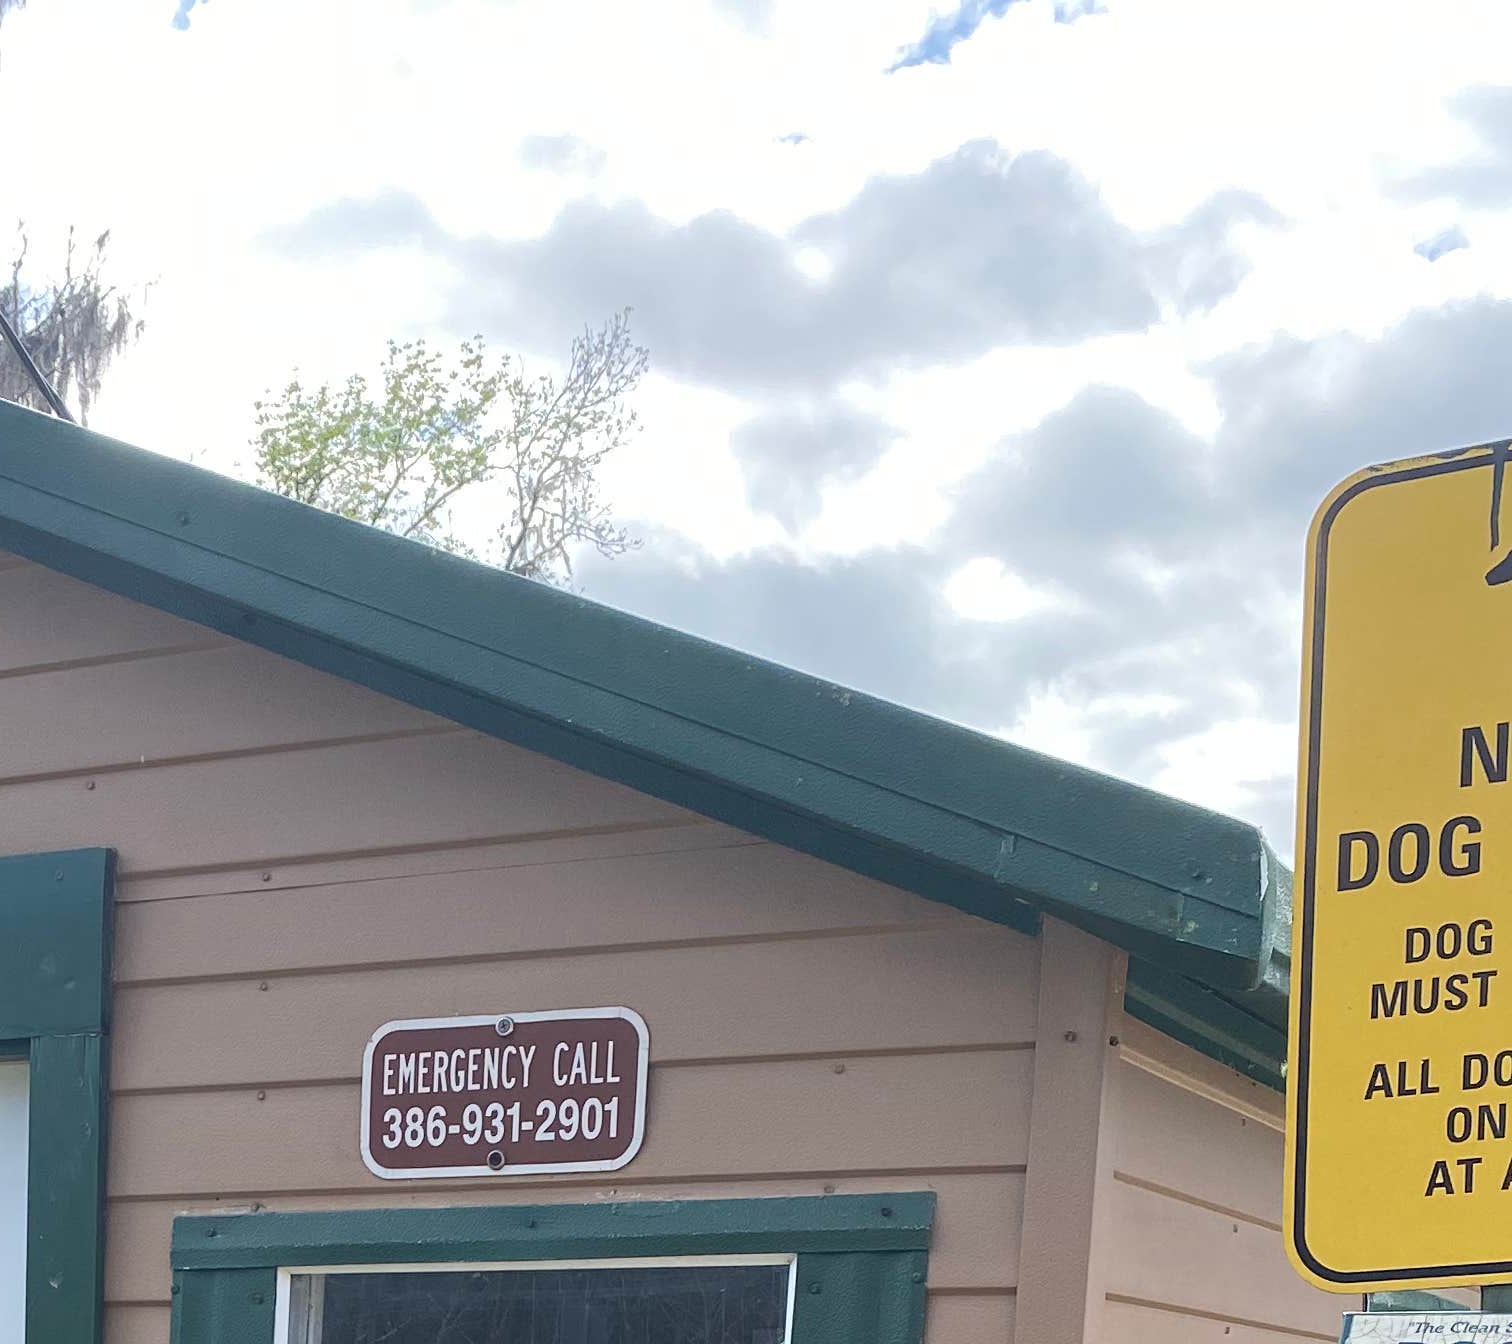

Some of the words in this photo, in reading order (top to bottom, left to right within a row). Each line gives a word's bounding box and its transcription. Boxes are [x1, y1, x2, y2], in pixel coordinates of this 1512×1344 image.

[1337, 816, 1482, 891] DOG
[1405, 919, 1493, 963] DOG
[1371, 970, 1498, 1019] MUST
[383, 1045, 536, 1095] EMERGENCY
[553, 1041, 620, 1086] CALL
[1364, 1059, 1440, 1100] ALL
[382, 1097, 619, 1149] 386-931-2901
[1447, 1103, 1507, 1143] ON
[1425, 1157, 1482, 1196] AT
[1451, 1321, 1500, 1334] Clean
